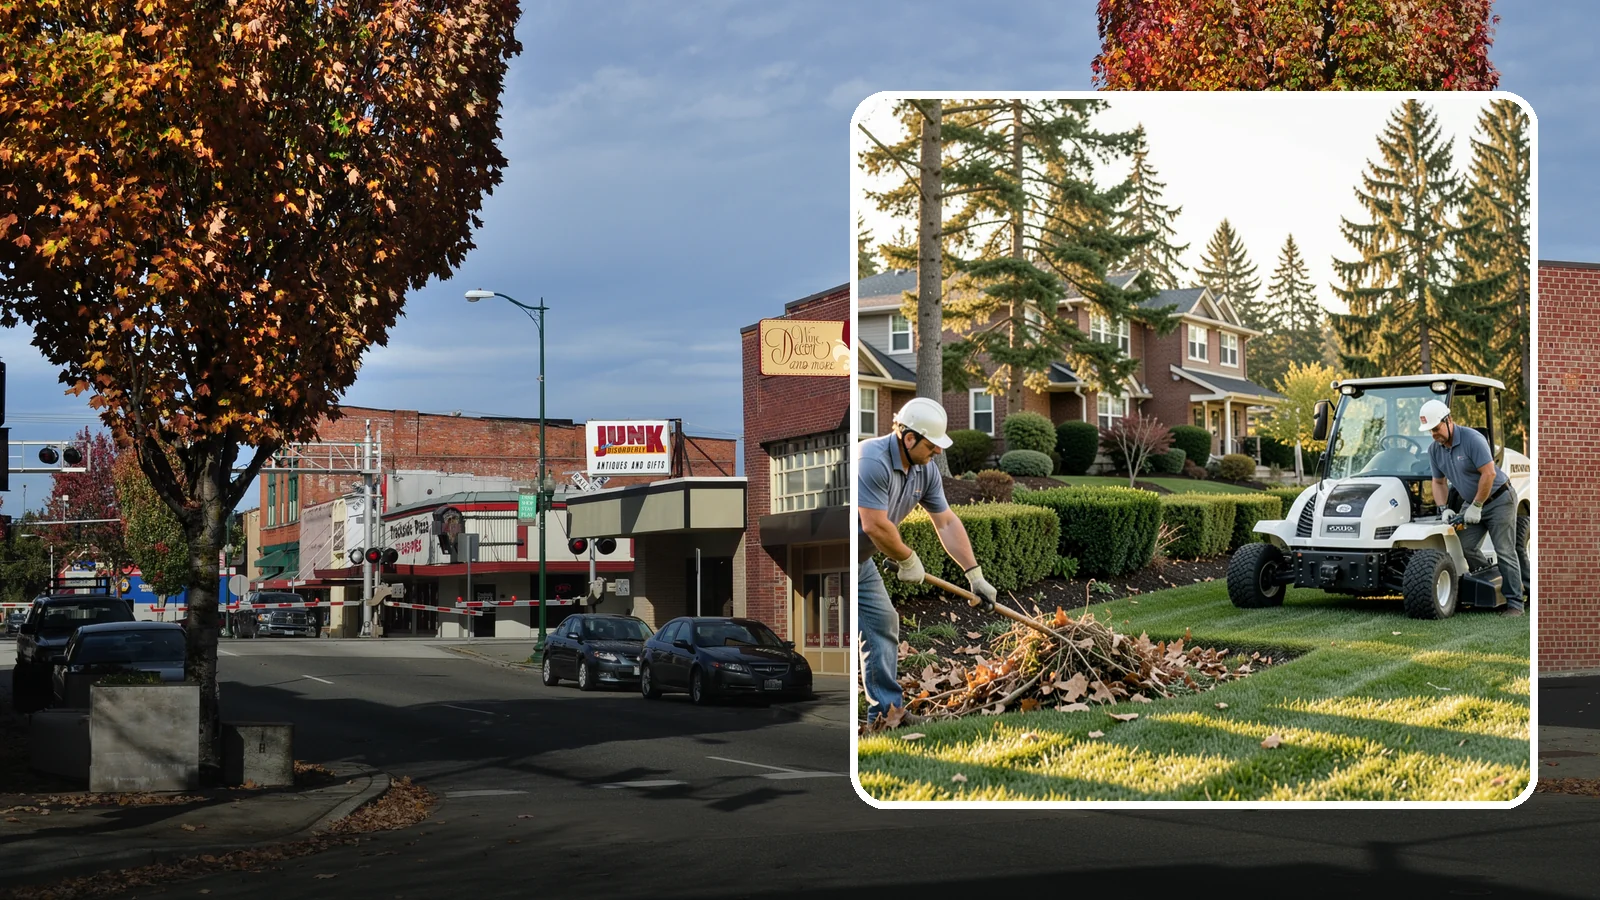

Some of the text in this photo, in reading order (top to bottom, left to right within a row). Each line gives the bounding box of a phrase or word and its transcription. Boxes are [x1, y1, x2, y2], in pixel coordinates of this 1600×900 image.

[595, 425, 665, 457] JUNK
[607, 446, 646, 454] DISORDERLY
[597, 460, 665, 470] ANTIQUES AND GIFTS
